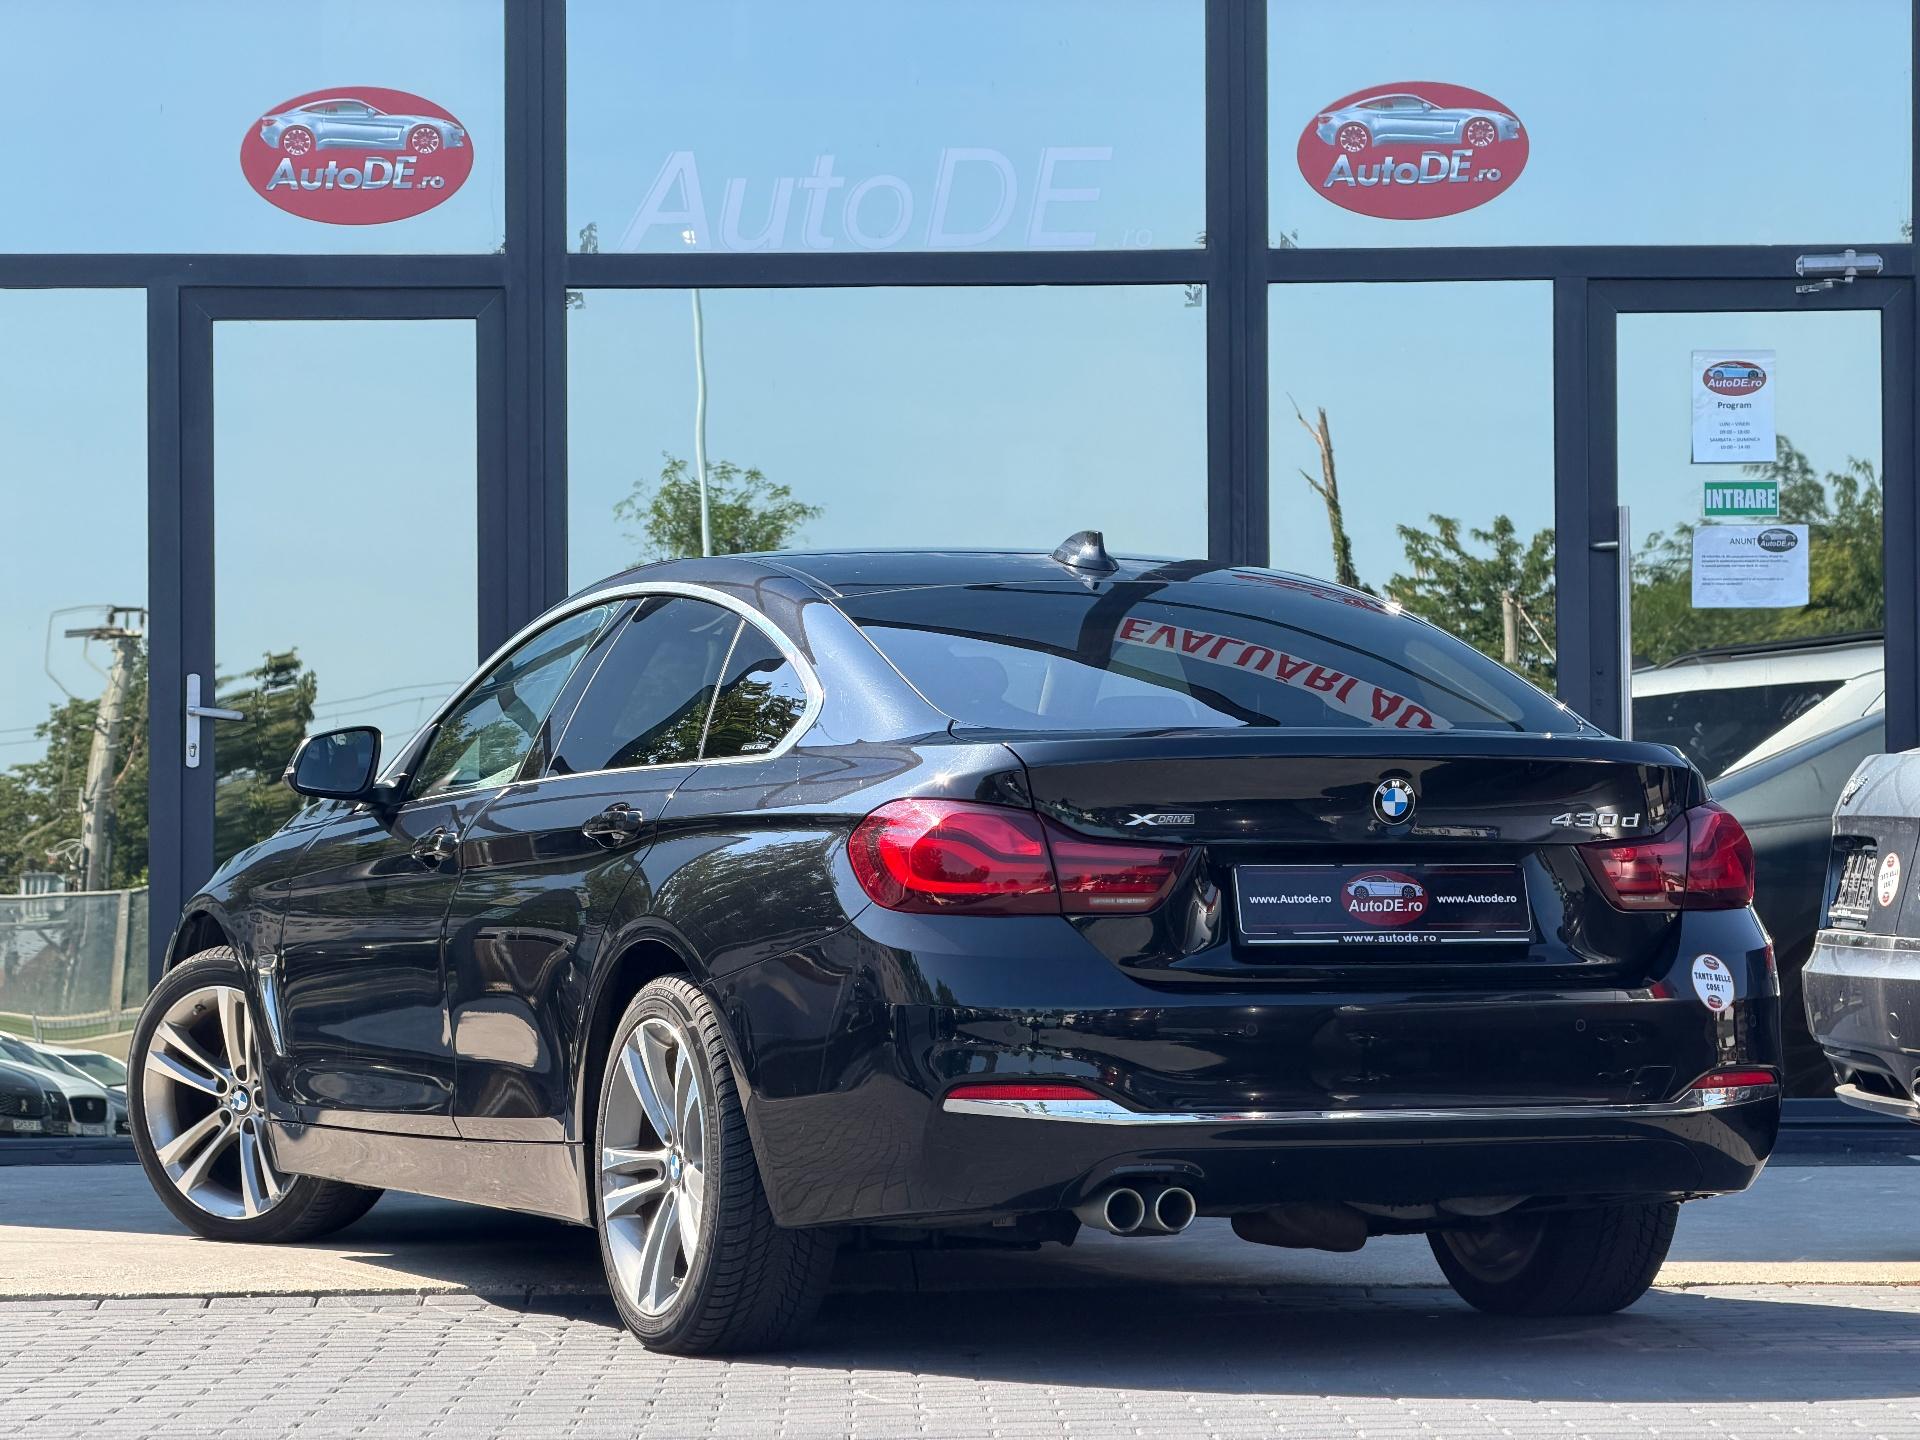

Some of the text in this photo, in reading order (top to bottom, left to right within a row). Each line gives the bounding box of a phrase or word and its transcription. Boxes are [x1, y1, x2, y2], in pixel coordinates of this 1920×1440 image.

[1708, 379, 1763, 388] AutoDE.ro
[1717, 401, 1752, 411] Program
[1706, 488, 1776, 509] INTRARE
[1379, 780, 1413, 796] BMW
[1550, 812, 1641, 828] 430d
[1249, 894, 1332, 904] www.Autode.ro
[1436, 894, 1517, 904] www.Autode.ro
[1349, 899, 1423, 912] AutoDE.ro
[1342, 933, 1437, 943] www.autode.ro
[1694, 972, 1731, 983] TANTE BELLE
